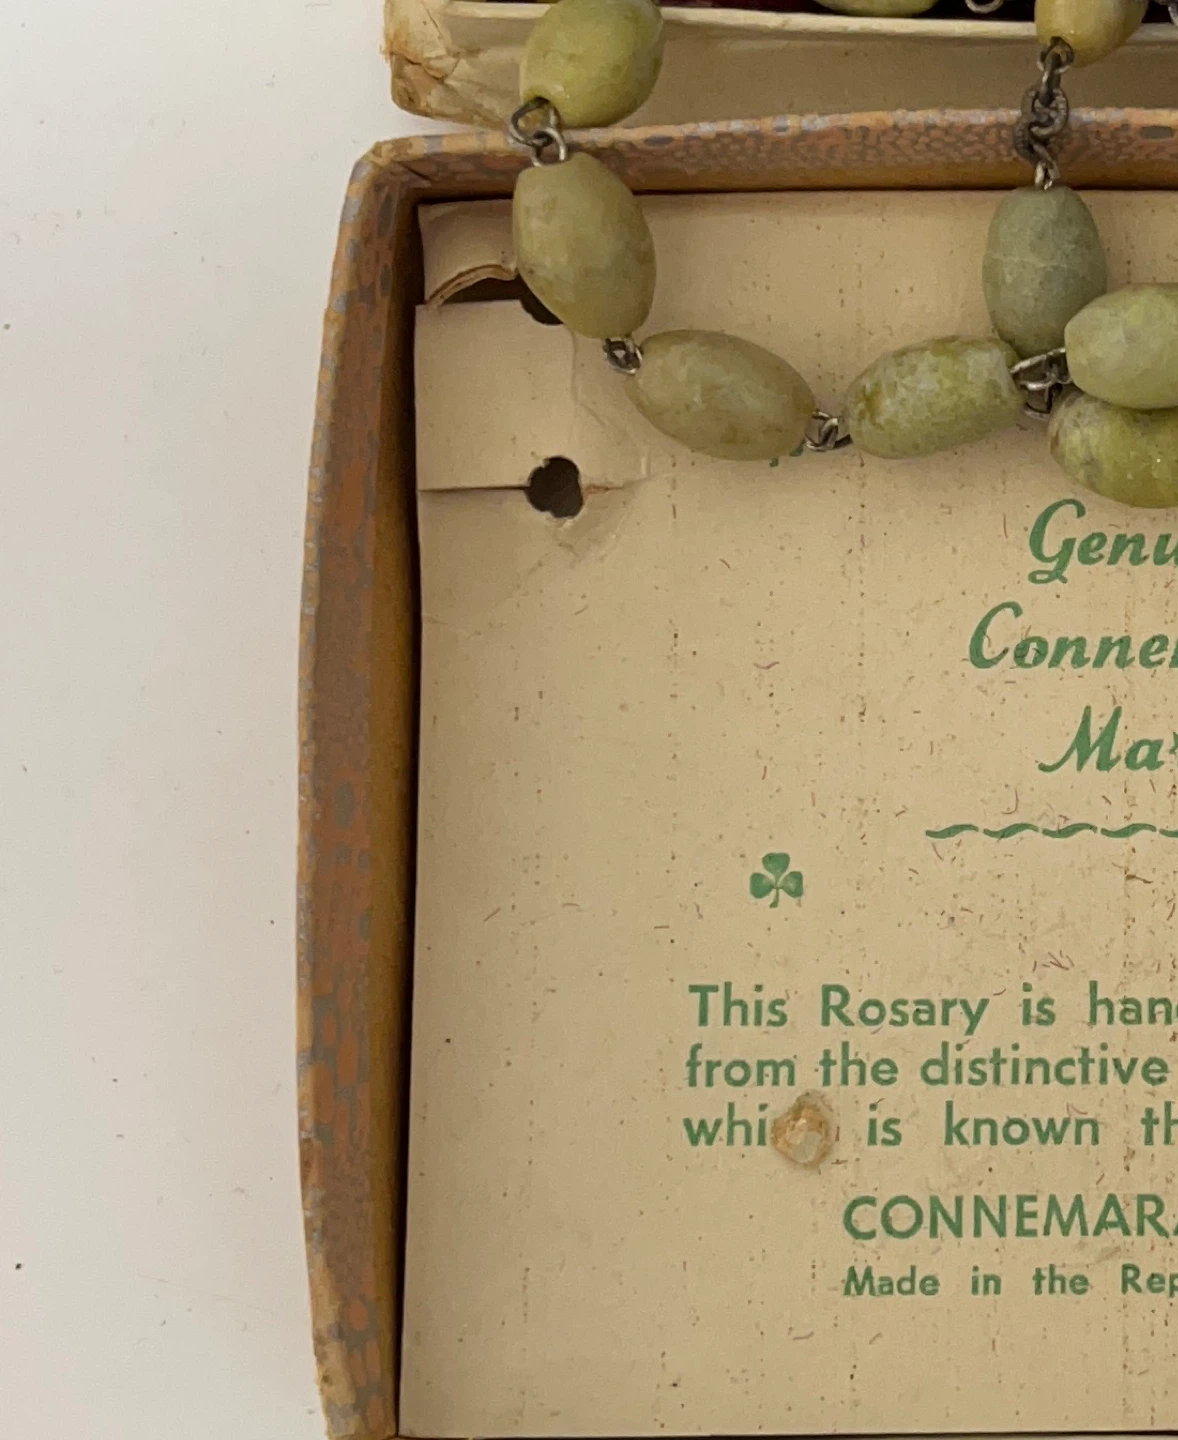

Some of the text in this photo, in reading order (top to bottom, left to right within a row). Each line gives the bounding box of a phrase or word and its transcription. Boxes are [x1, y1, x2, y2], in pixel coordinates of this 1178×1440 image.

[689, 981, 788, 1027] This
[820, 984, 990, 1035] Rosary
[1021, 982, 1056, 1026] is
[686, 1043, 796, 1087] from
[819, 1041, 899, 1086] the
[920, 1040, 1169, 1086] distinctive
[683, 1100, 815, 1147] whi
[867, 1103, 902, 1147] is
[944, 1100, 1100, 1146] known
[843, 1266, 940, 1296] Made
[971, 1266, 1001, 1295] in
[1032, 1264, 1090, 1295] the
